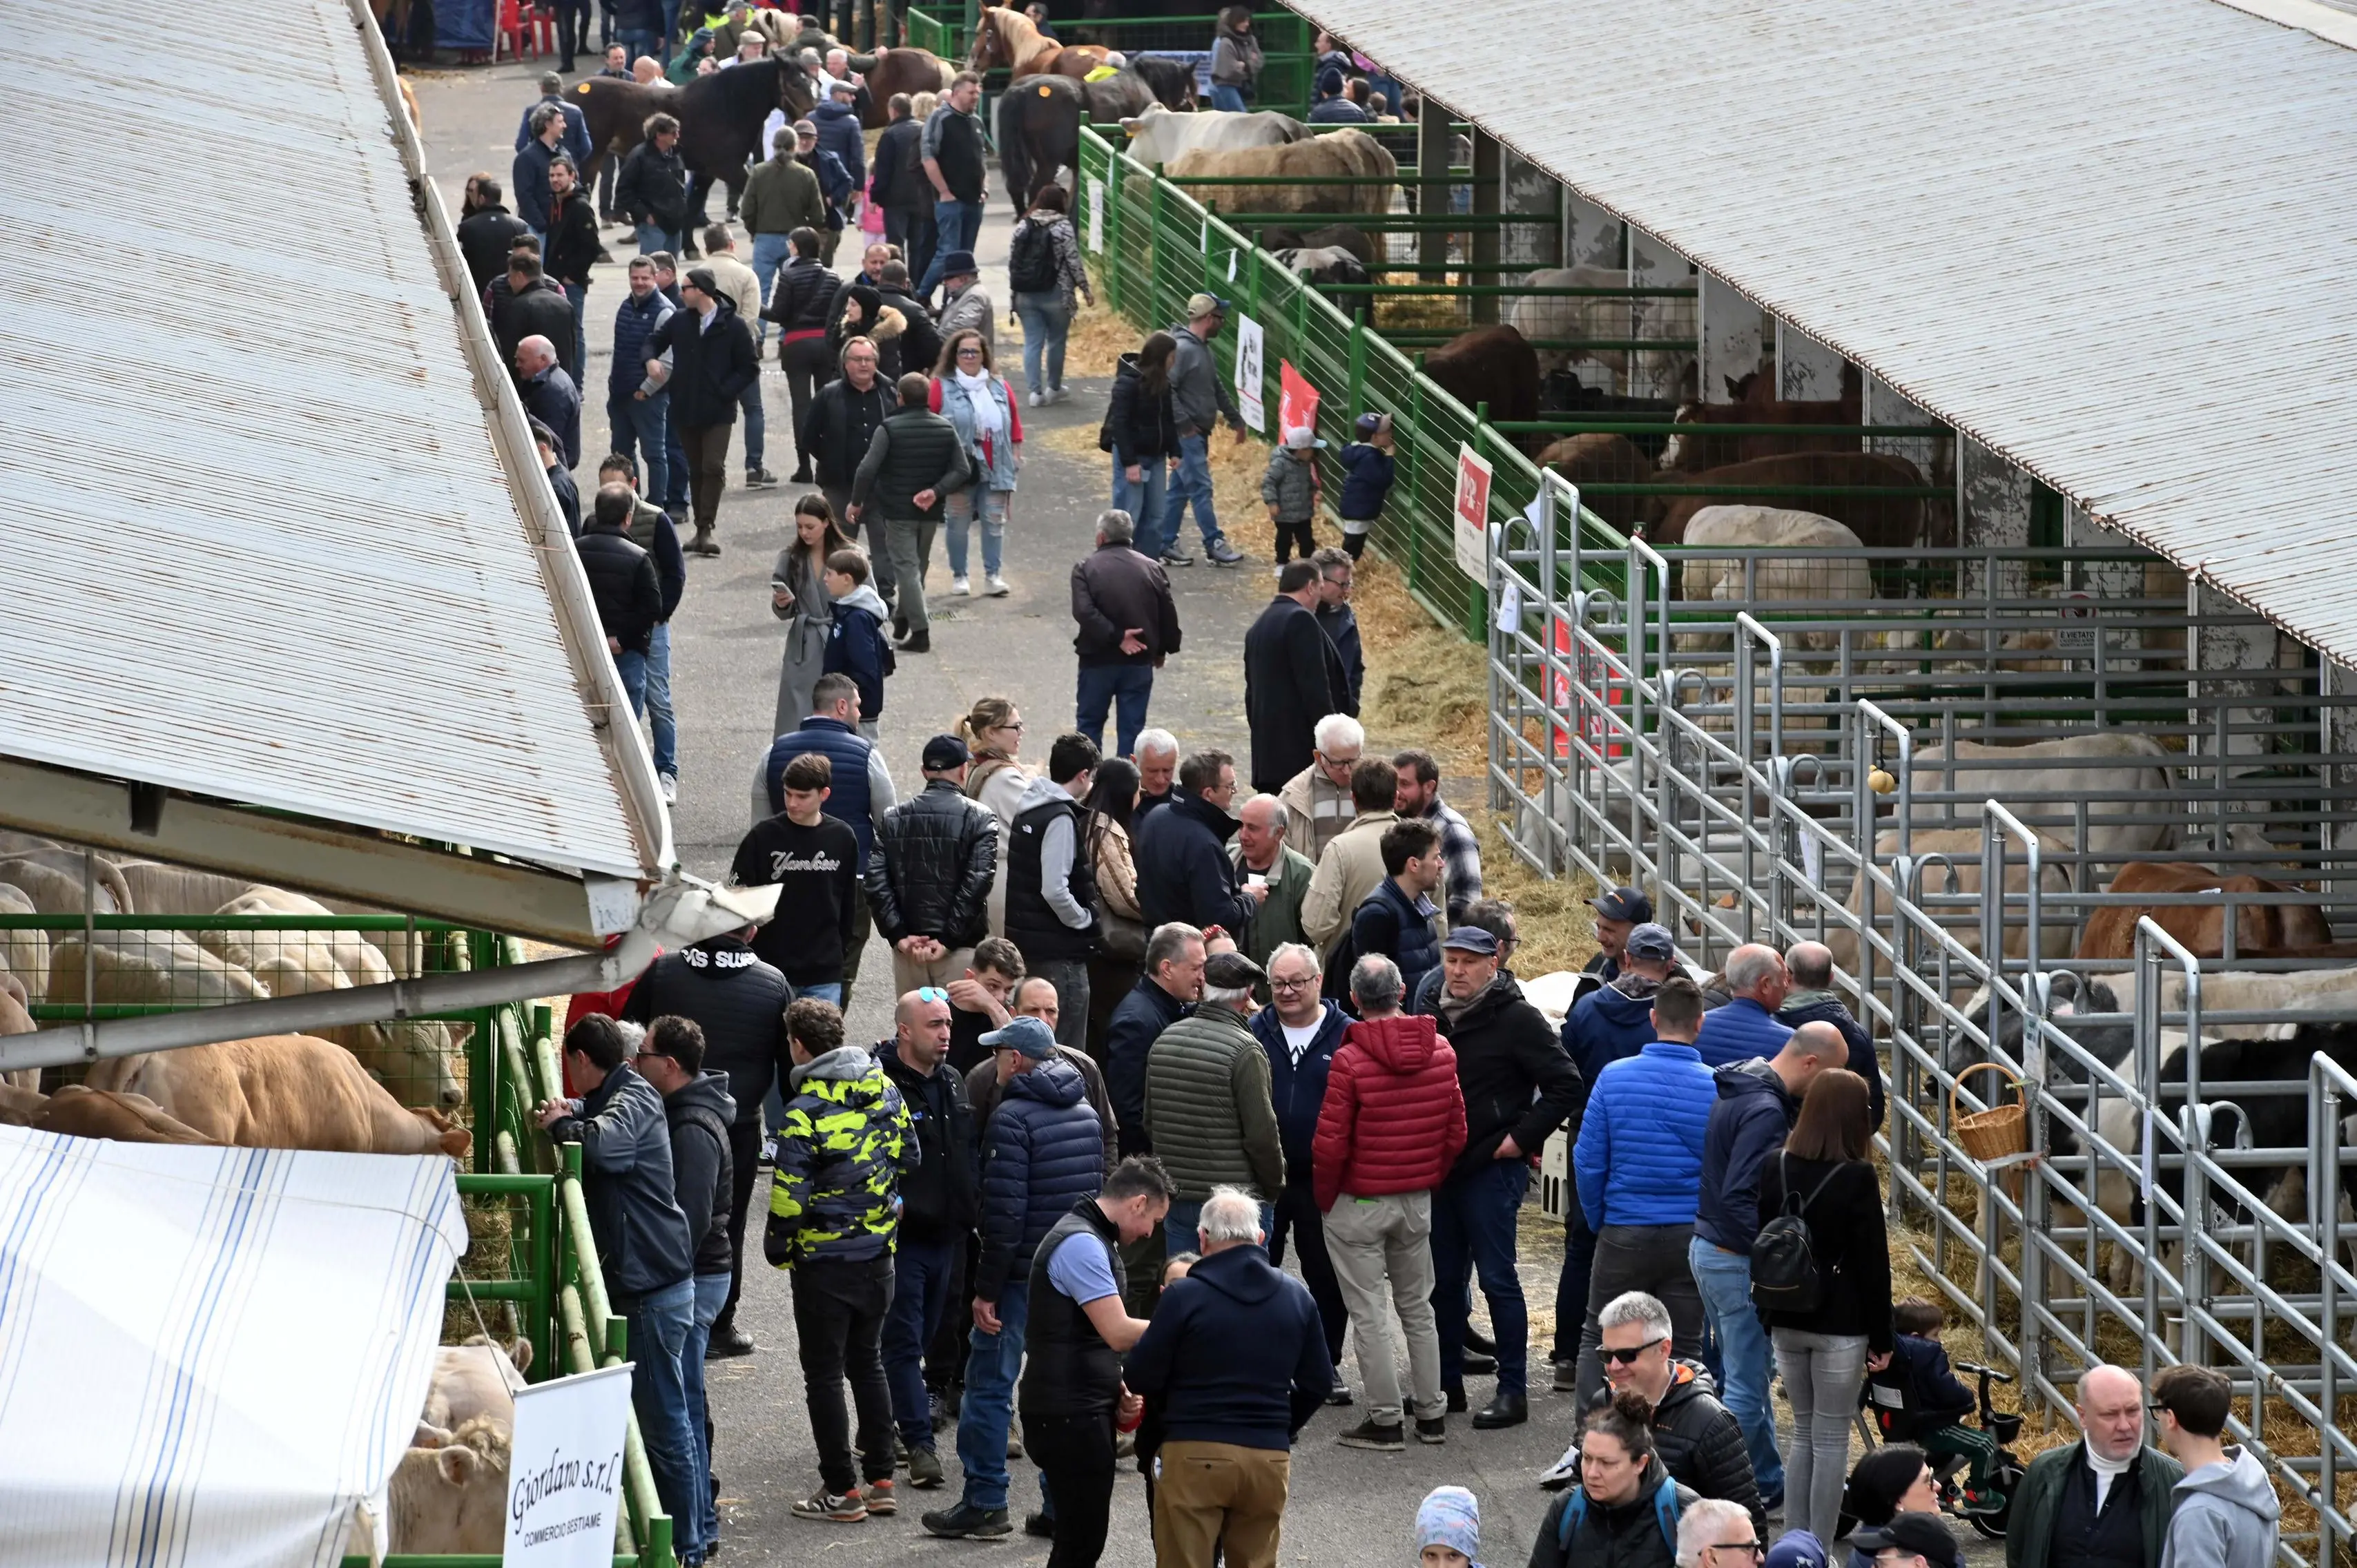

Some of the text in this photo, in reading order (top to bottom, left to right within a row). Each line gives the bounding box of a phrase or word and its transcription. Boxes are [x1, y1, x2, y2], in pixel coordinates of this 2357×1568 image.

[513, 1447, 580, 1536] Giordano
[524, 1512, 601, 1548] COMMERCIO BESTIAME
